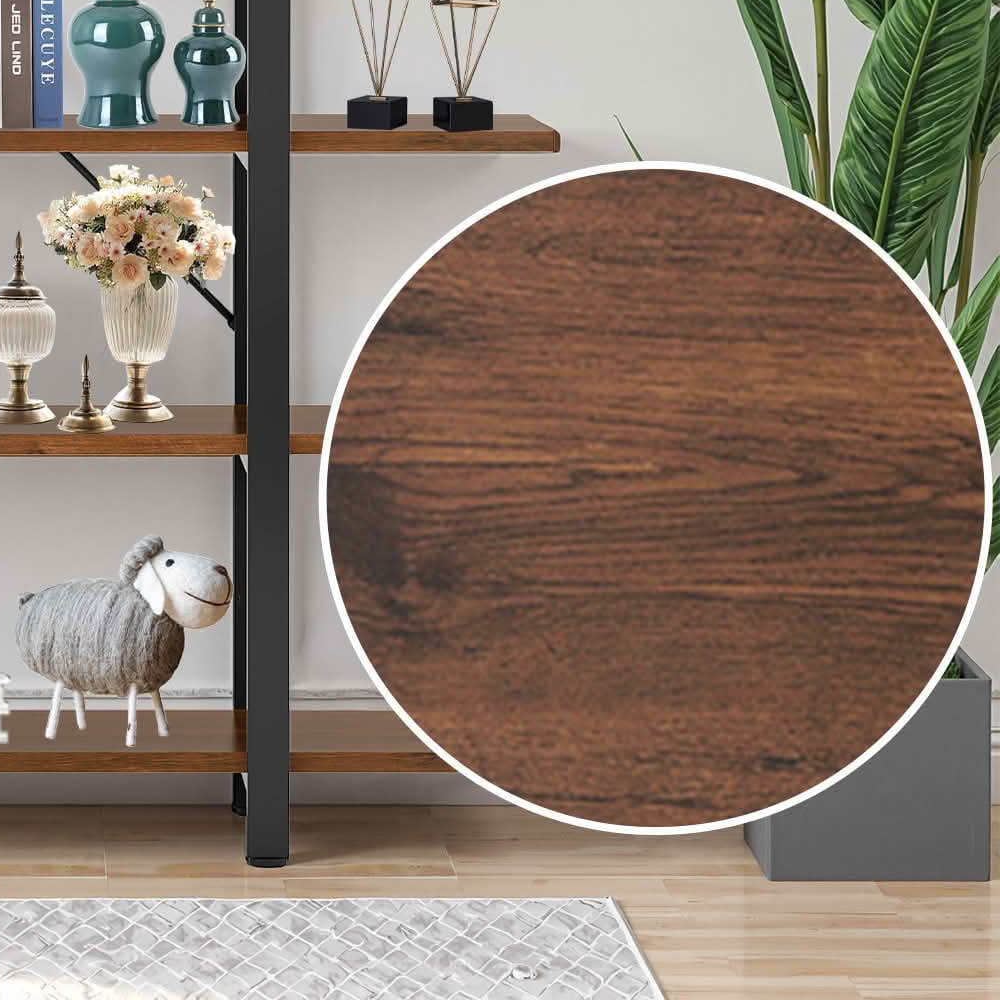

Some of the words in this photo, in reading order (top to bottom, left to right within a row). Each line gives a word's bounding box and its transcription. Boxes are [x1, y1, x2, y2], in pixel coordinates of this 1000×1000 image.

[11, 3, 21, 35] JED
[12, 40, 22, 76] LIND
[40, 0, 55, 85] LECUYE
